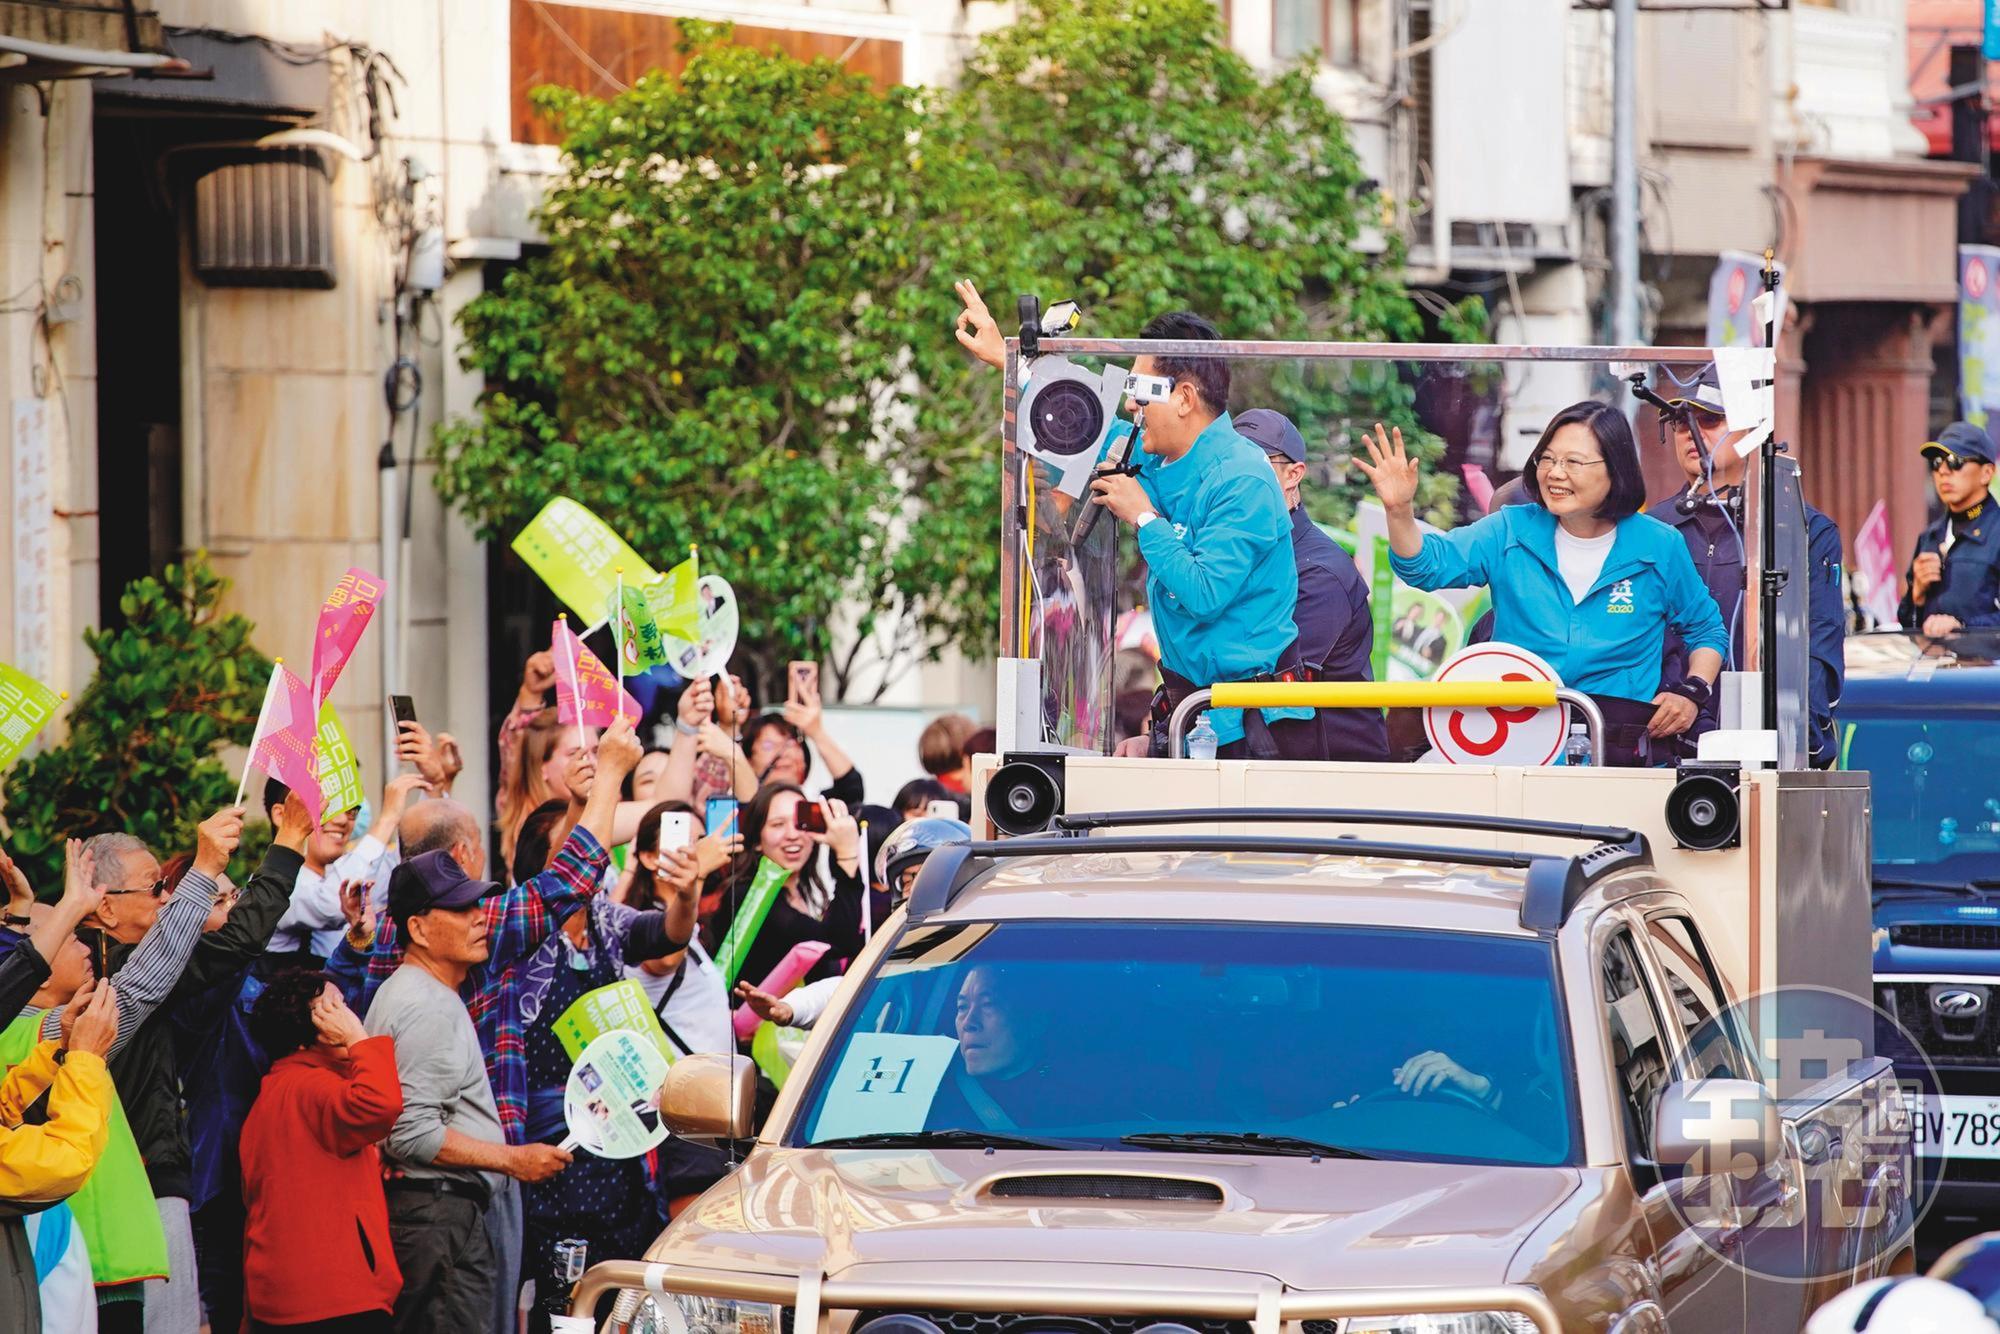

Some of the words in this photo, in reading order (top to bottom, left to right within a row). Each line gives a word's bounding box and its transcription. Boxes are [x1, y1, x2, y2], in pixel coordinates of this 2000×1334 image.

[1607, 604, 1634, 614] 2020
[1609, 579, 1634, 604] 英
[1448, 673, 1540, 756] 3
[322, 721, 358, 806] 2020
